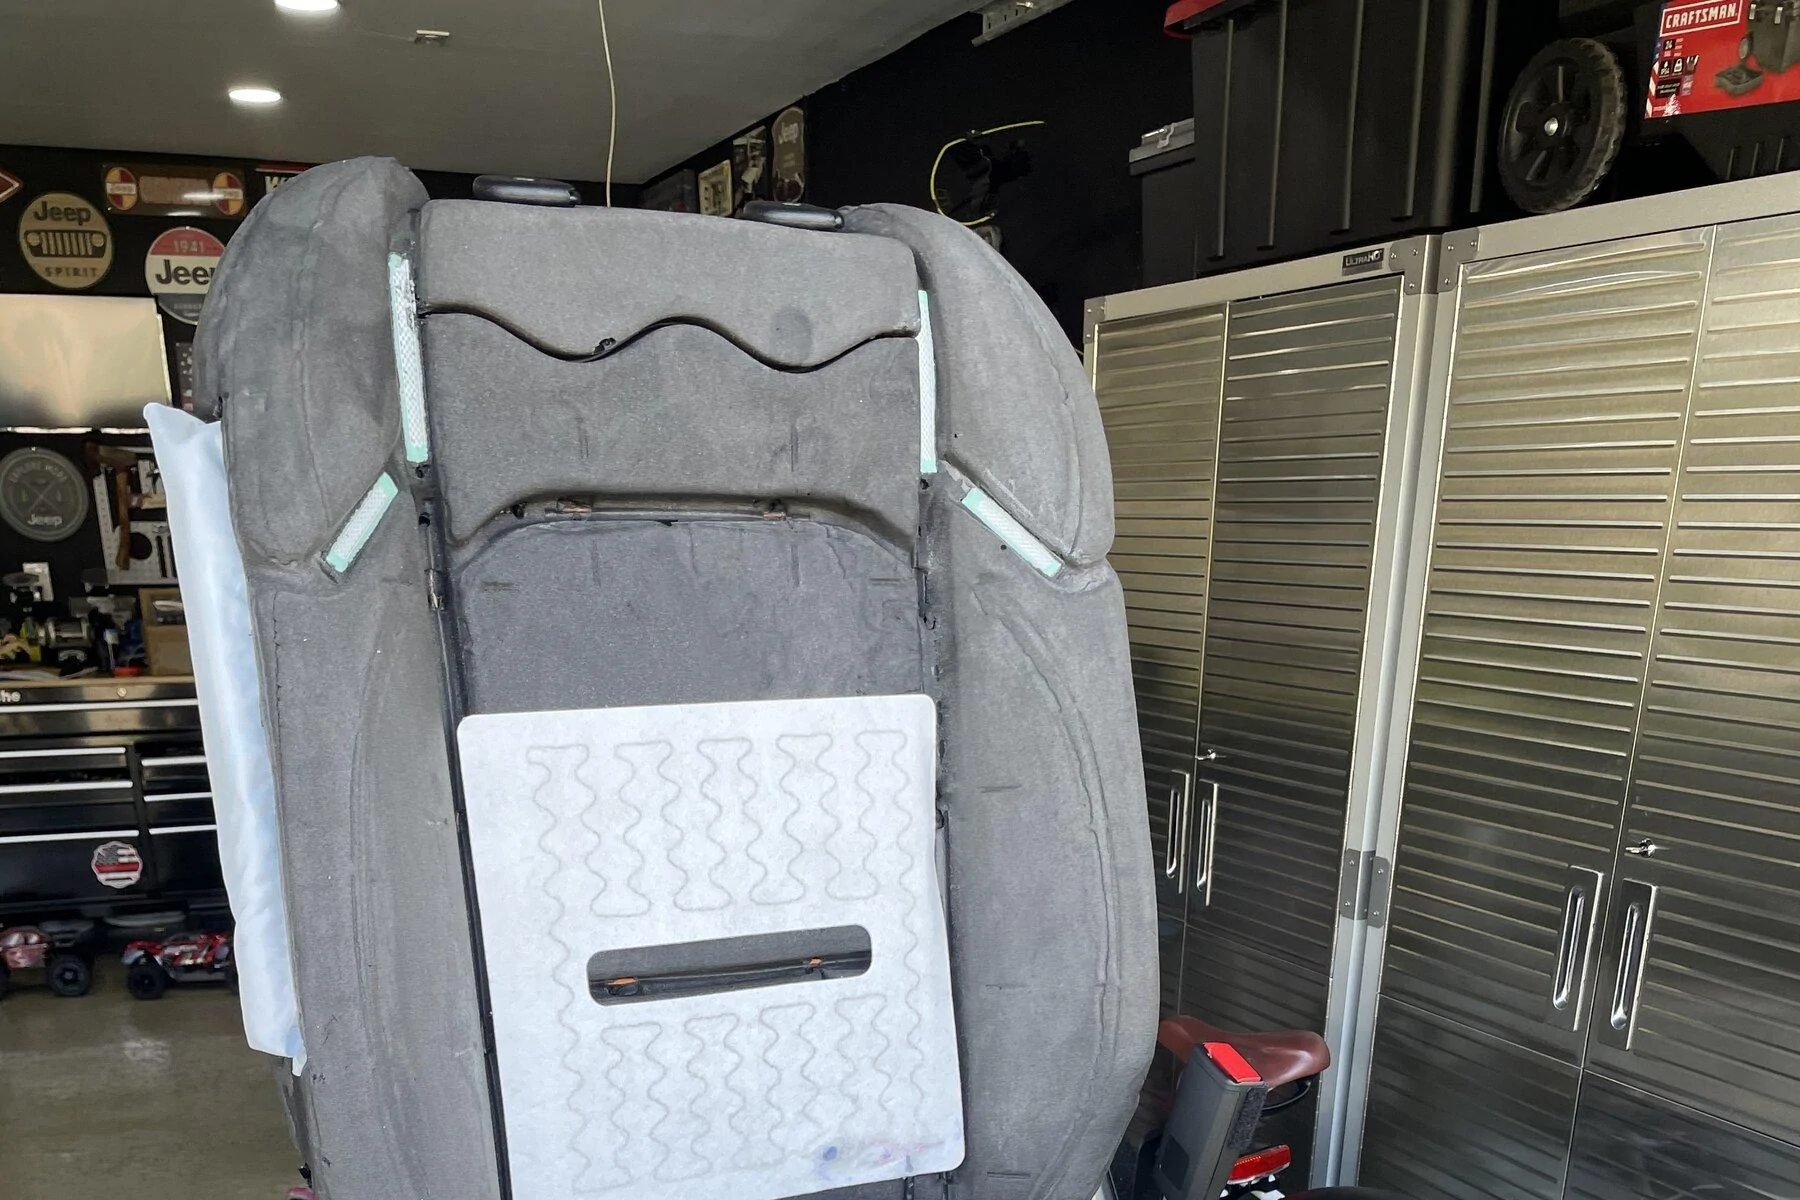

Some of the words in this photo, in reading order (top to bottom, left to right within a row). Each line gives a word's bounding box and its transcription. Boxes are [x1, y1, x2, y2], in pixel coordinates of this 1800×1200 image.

[1665, 2, 1737, 29] CRAFTSMAN
[33, 201, 91, 226] Jeep
[44, 266, 98, 278] SPIRIT
